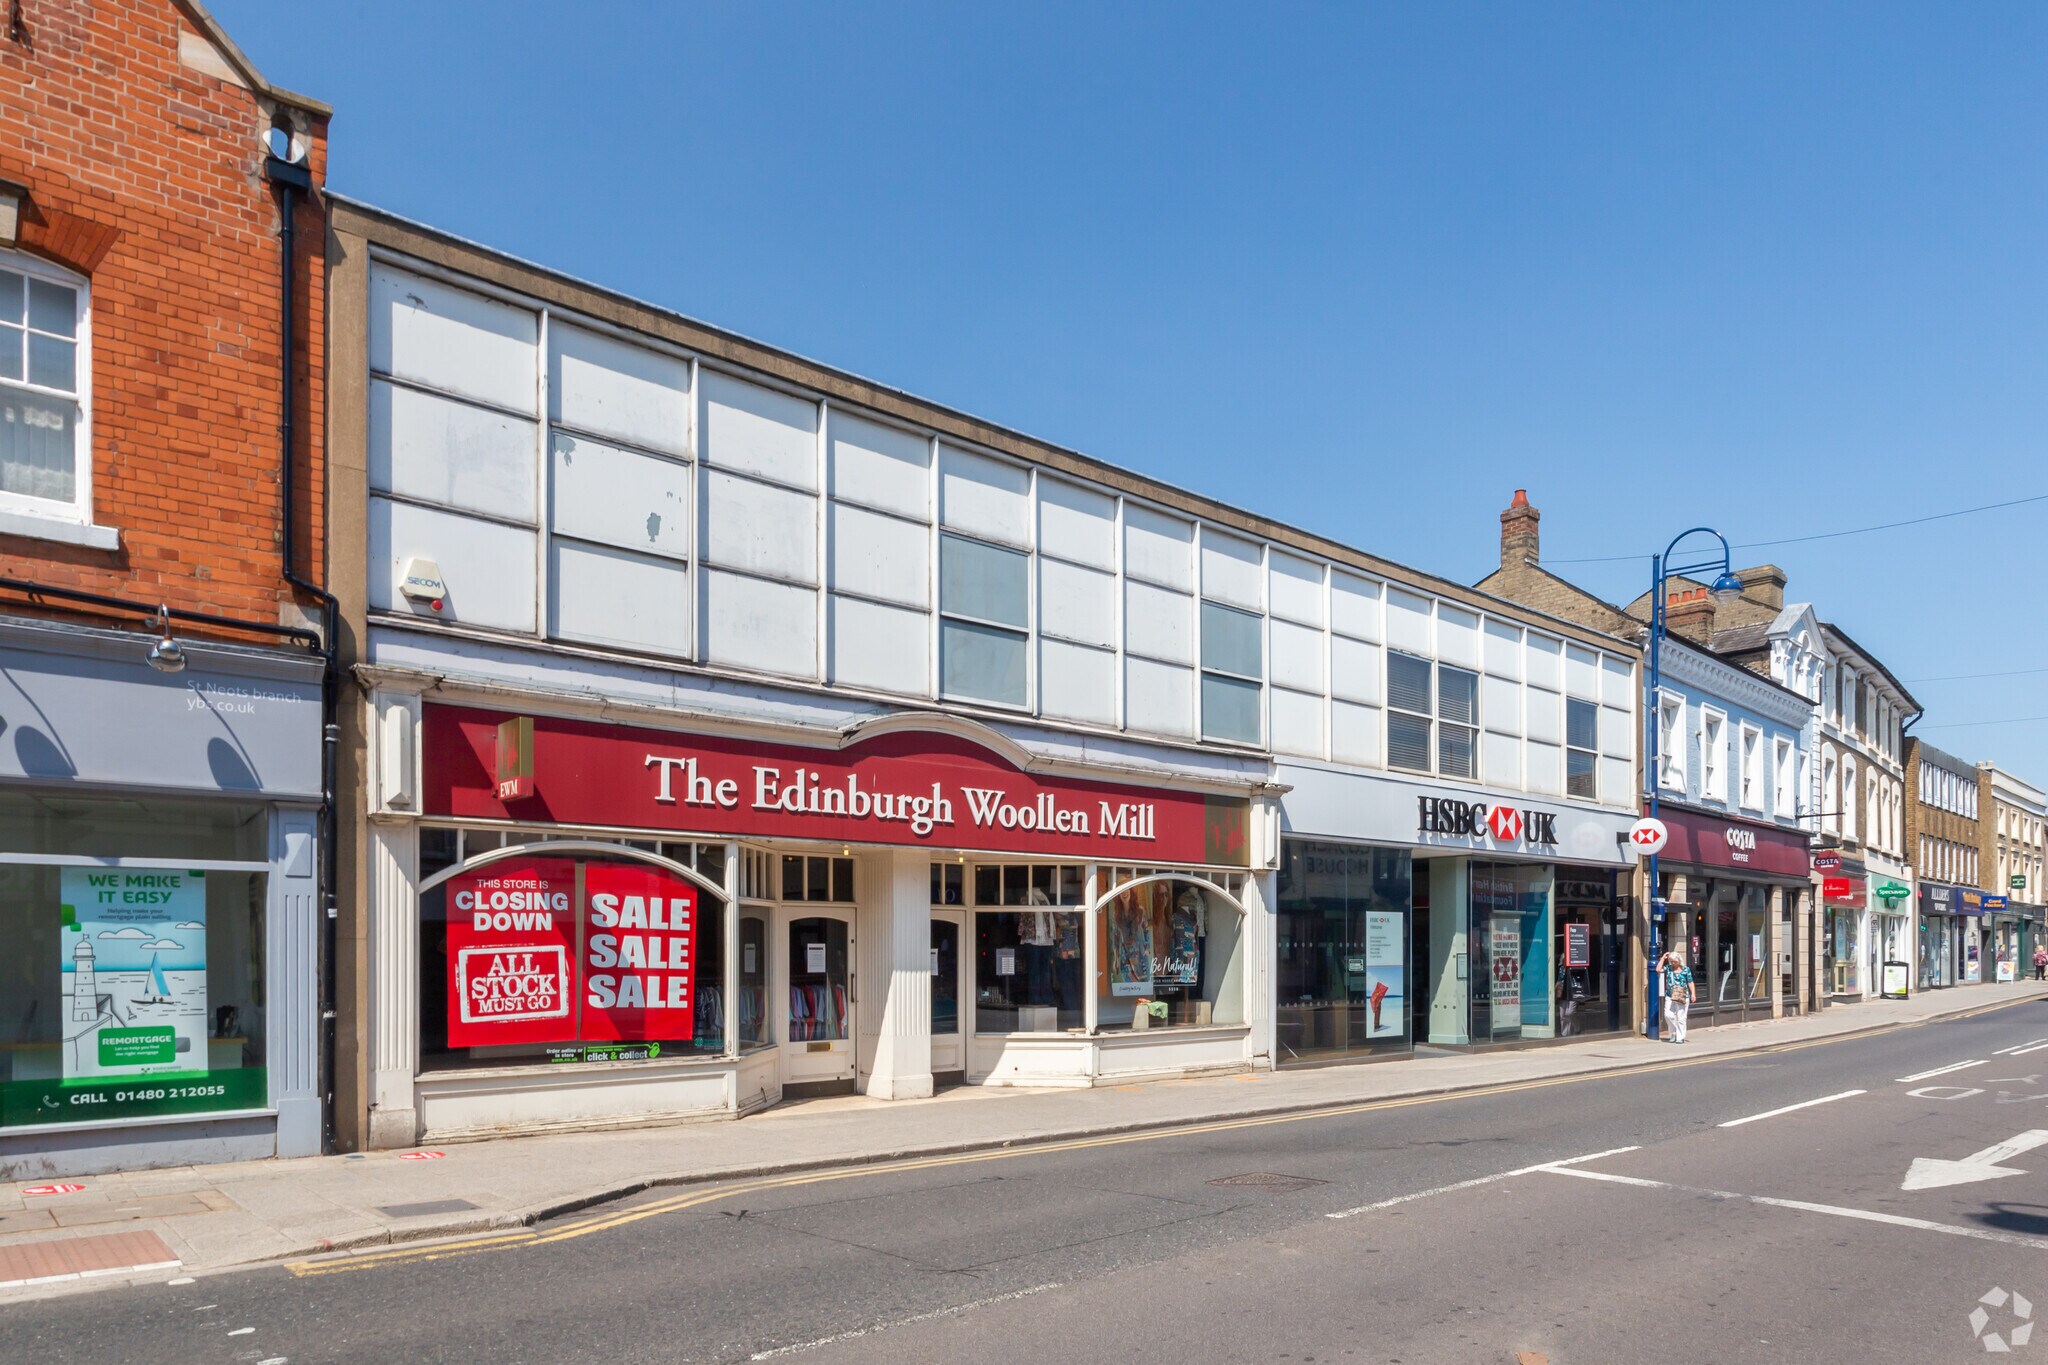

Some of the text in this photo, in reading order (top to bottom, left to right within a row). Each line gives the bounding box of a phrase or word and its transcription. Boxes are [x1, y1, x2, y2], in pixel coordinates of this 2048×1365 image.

[407, 576, 440, 589] SECOM
[187, 680, 301, 703] St Neots branch
[187, 697, 255, 714] ybs.co.uk
[500, 779, 518, 798] EWM
[644, 754, 1156, 839] The Edinburgh Woollen Mill
[1417, 795, 1559, 844] HSBC UK
[1726, 827, 1756, 850] COSTA
[1732, 853, 1749, 862] COFFEE
[88, 874, 181, 888] WE MAKE
[477, 879, 549, 889] THIS STORE IS
[98, 891, 172, 904] IT EASY
[455, 891, 569, 911] CLOSING
[474, 912, 552, 931] DOWN
[591, 893, 691, 931] SALE
[589, 933, 689, 970] SALE
[488, 953, 540, 977] ALL
[1150, 957, 1162, 974] Be
[471, 973, 557, 1000] STOCK
[588, 974, 688, 1008] SALE
[478, 995, 551, 1013] MUST GO
[102, 1035, 171, 1045] REMORTGAGE
[587, 1050, 648, 1061] click & collect
[70, 1085, 225, 1105] CALL 01480 212055
